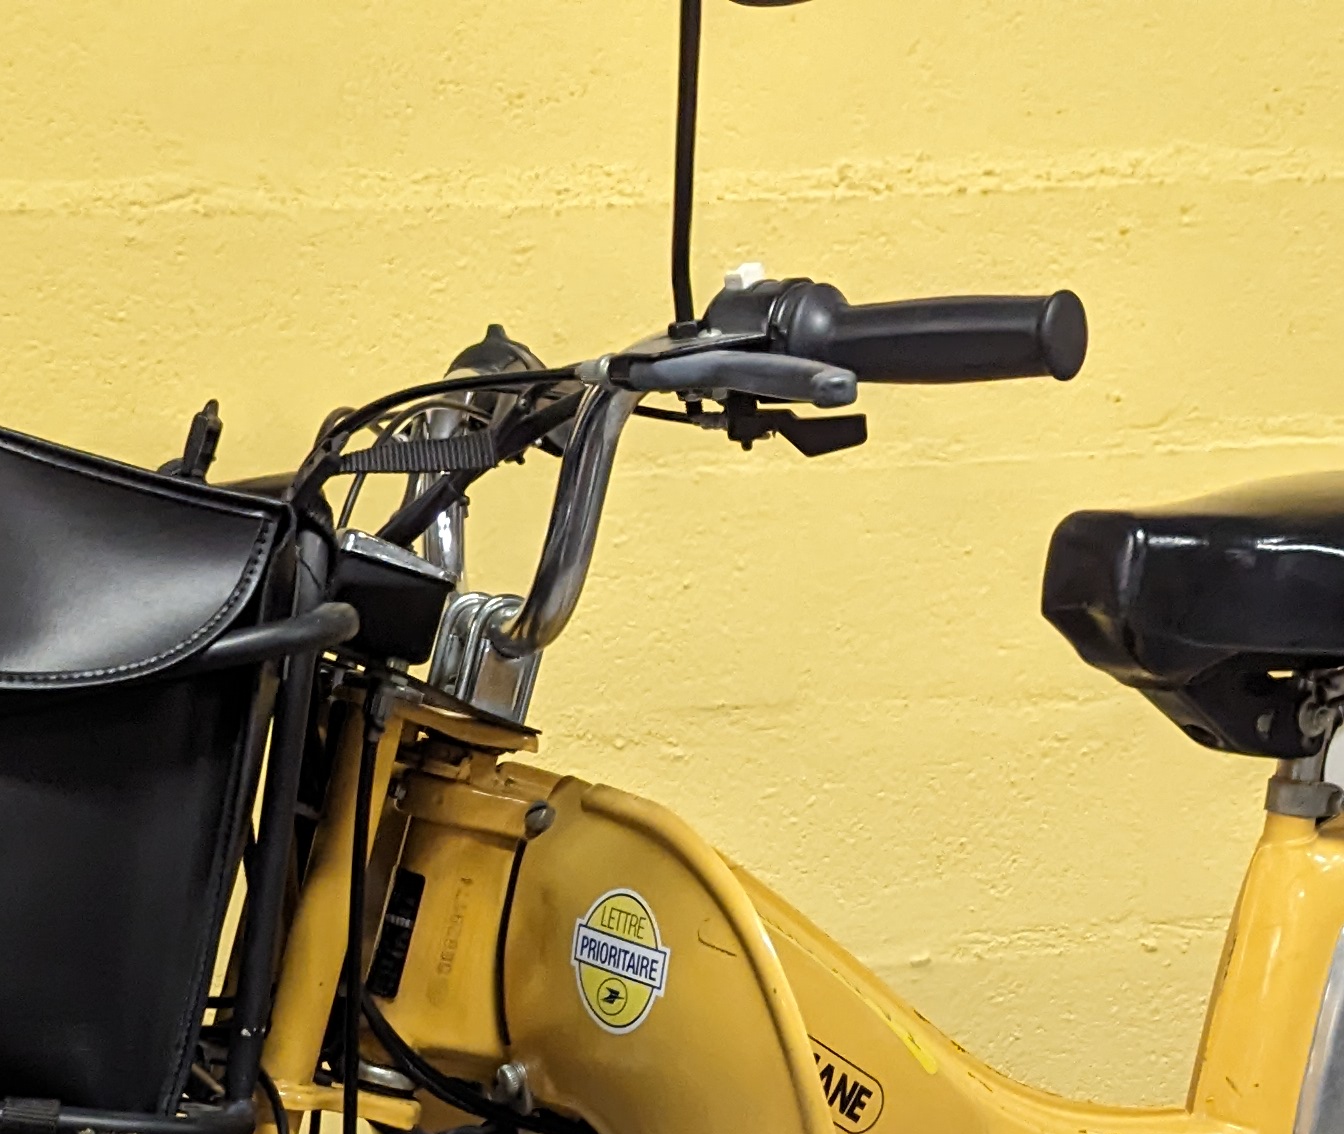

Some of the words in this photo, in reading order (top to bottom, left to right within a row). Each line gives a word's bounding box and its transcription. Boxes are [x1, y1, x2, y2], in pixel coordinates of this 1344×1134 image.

[600, 906, 647, 939] LETTRE
[580, 936, 659, 981] PRIORITAIRE
[814, 1053, 873, 1123] ANE
